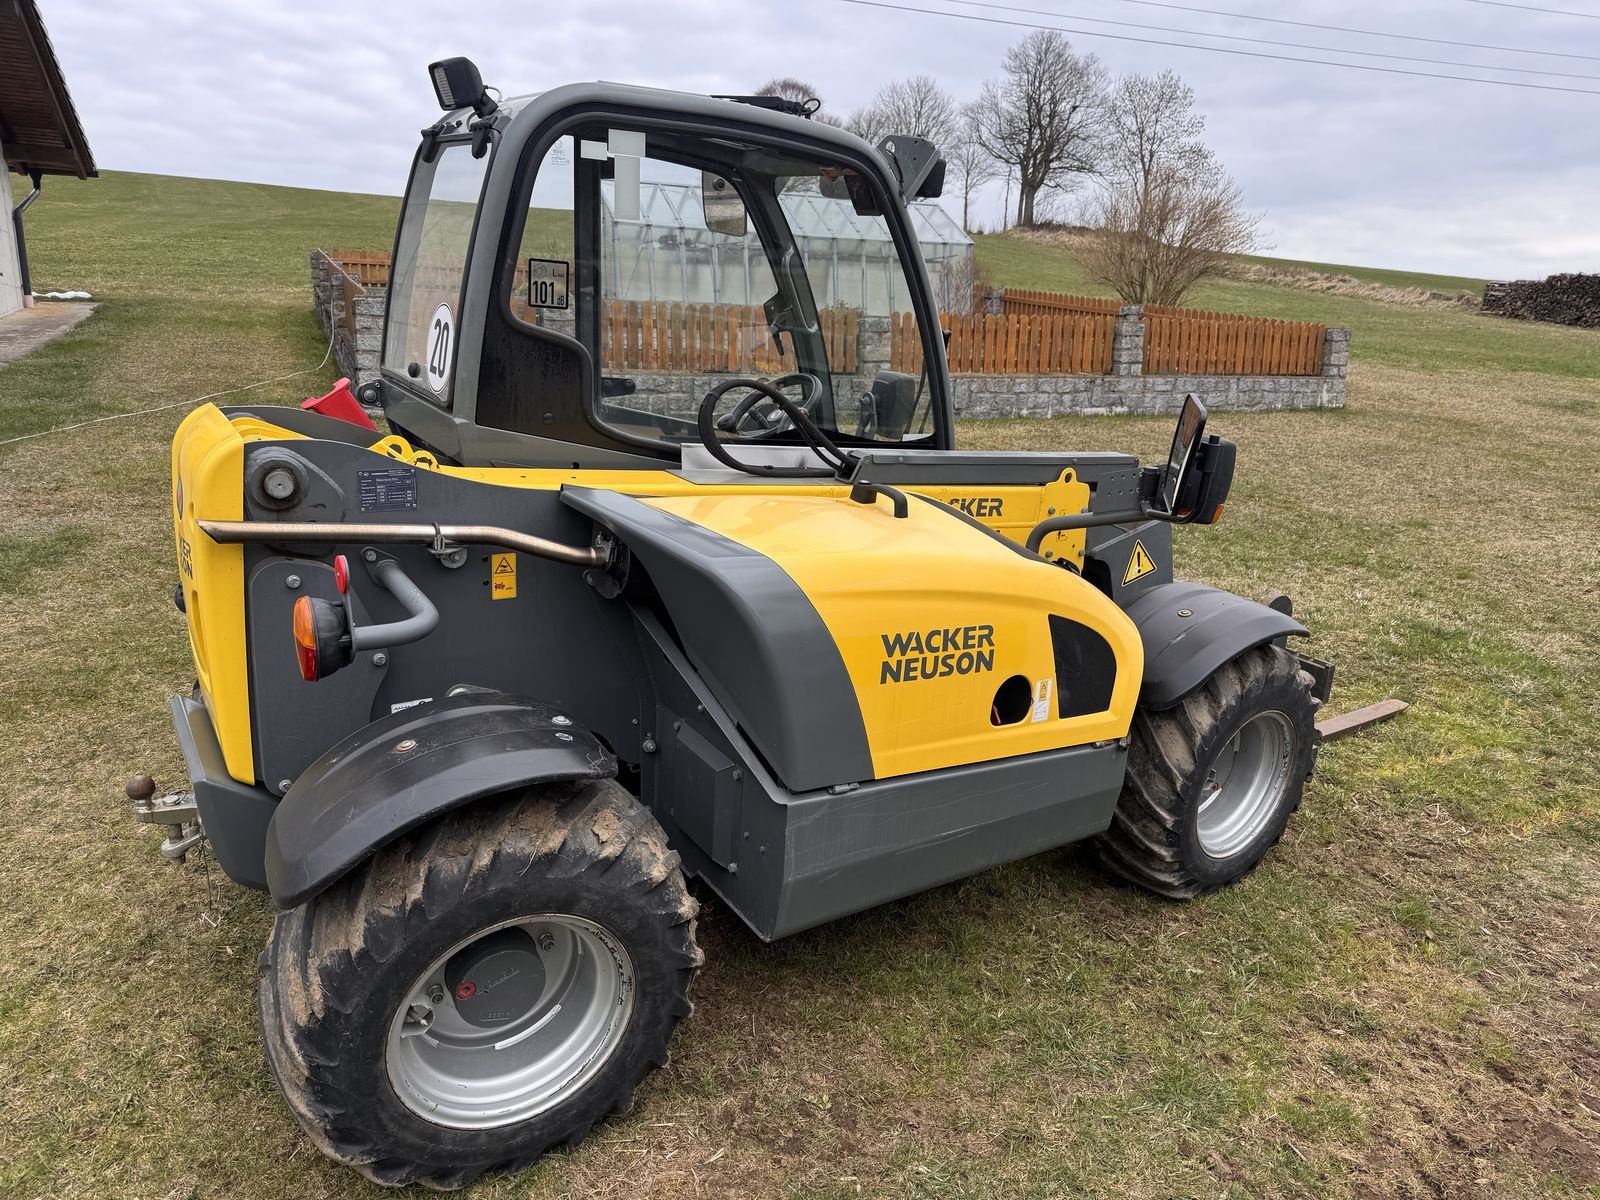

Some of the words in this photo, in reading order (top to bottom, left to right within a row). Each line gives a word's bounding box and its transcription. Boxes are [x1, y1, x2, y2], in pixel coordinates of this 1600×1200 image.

[532, 280, 554, 305] 101
[556, 295, 565, 306] dB
[429, 318, 450, 379] 20
[880, 624, 995, 658] WACKER
[880, 649, 995, 685] NEUSON
